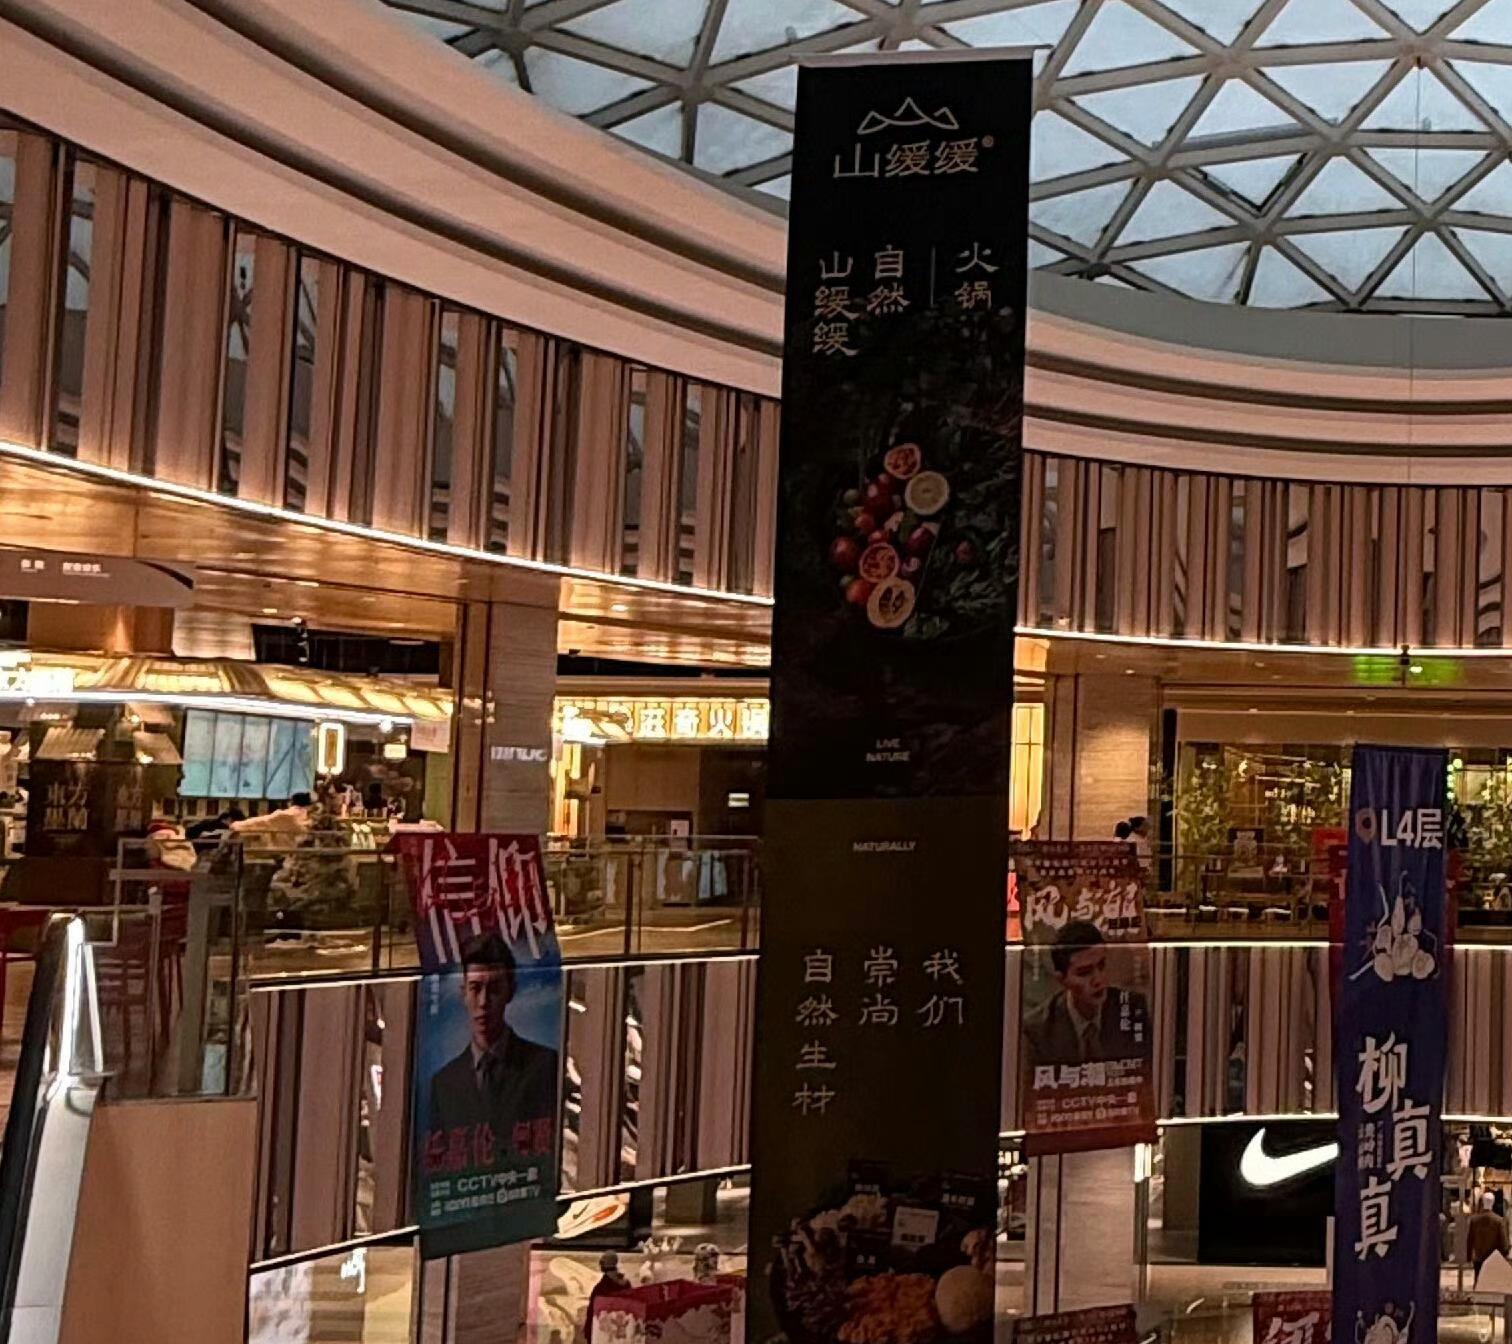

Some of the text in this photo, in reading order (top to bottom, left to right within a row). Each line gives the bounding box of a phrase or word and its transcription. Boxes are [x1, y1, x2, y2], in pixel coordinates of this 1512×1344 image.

[832, 139, 979, 179] 山缓缓
[812, 251, 861, 356] 山缓缓
[866, 247, 910, 315] 自然
[955, 242, 999, 310] 火锅
[1380, 808, 1443, 850] L4层
[858, 946, 899, 1027] 崇尚
[917, 951, 964, 1027] 我们
[792, 949, 838, 1117] 自然生材
[1355, 1032, 1433, 1262] 柳真真
